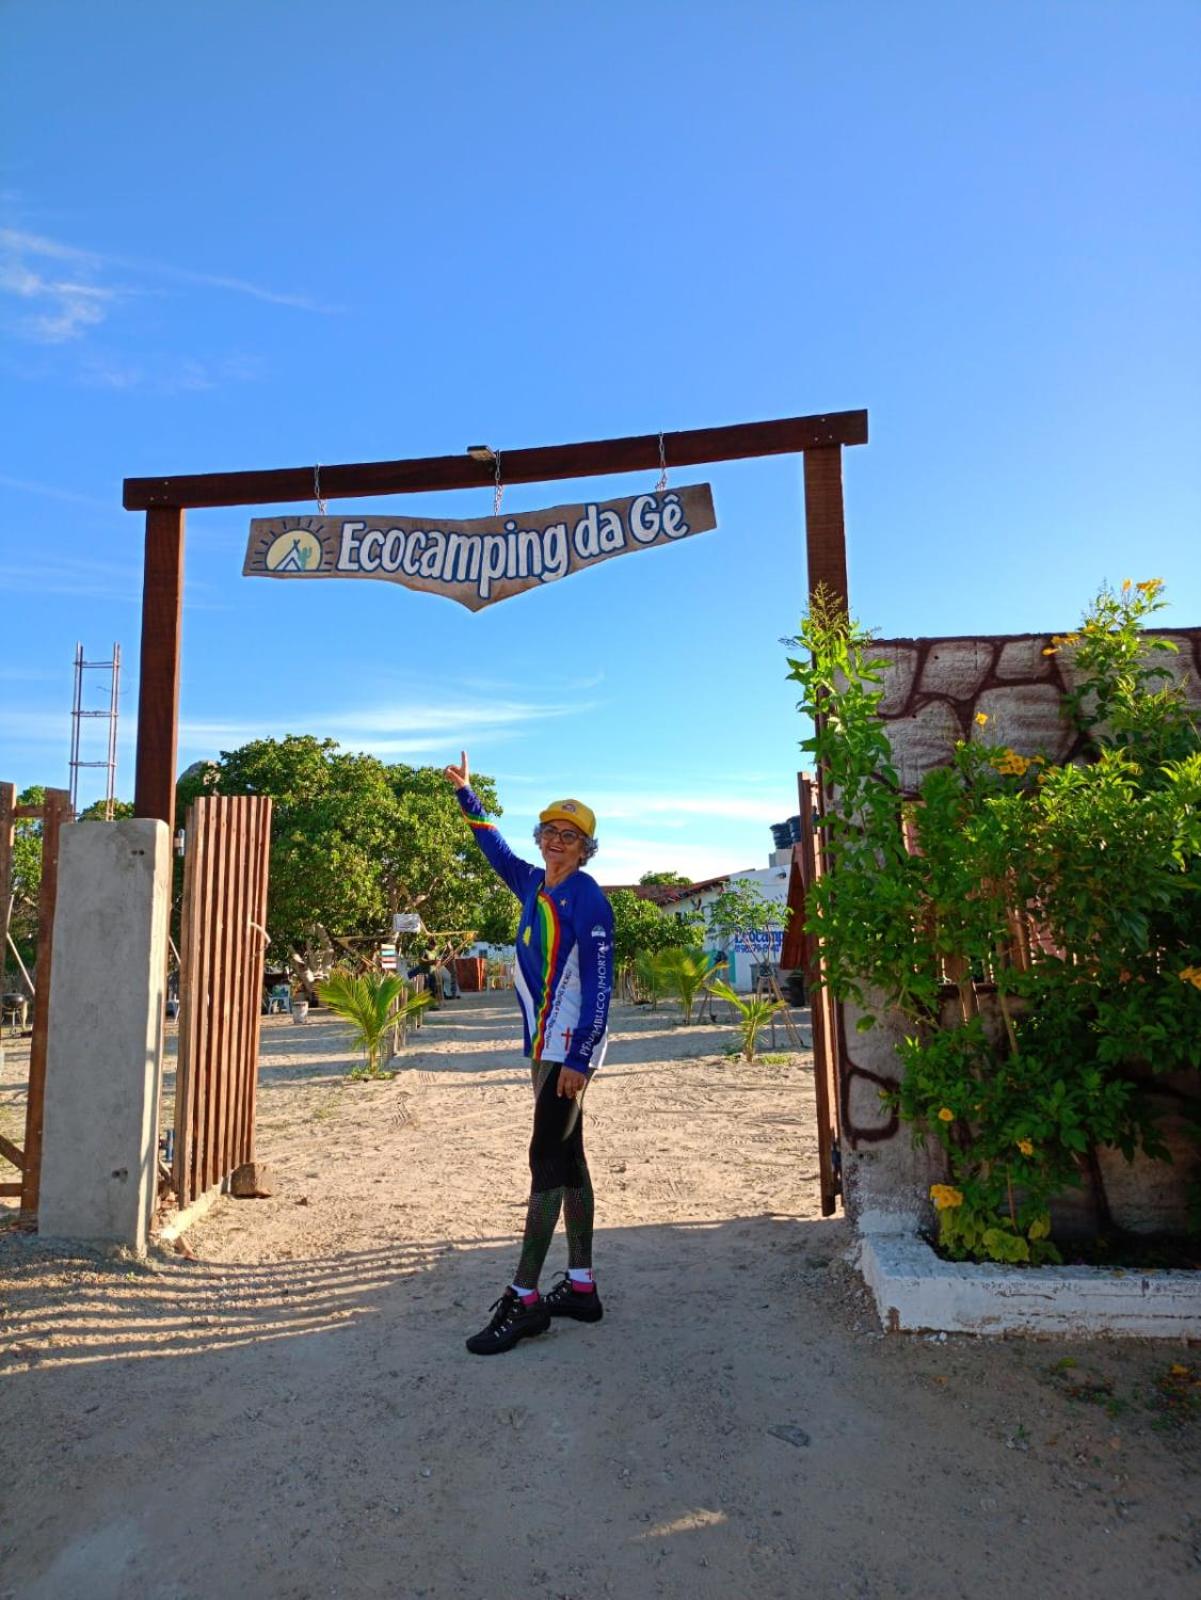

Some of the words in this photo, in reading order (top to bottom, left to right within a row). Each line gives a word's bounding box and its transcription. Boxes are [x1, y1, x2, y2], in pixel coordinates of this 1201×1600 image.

[336, 522, 569, 599] Ecocamping
[575, 503, 626, 559] da
[630, 493, 691, 543] Gê
